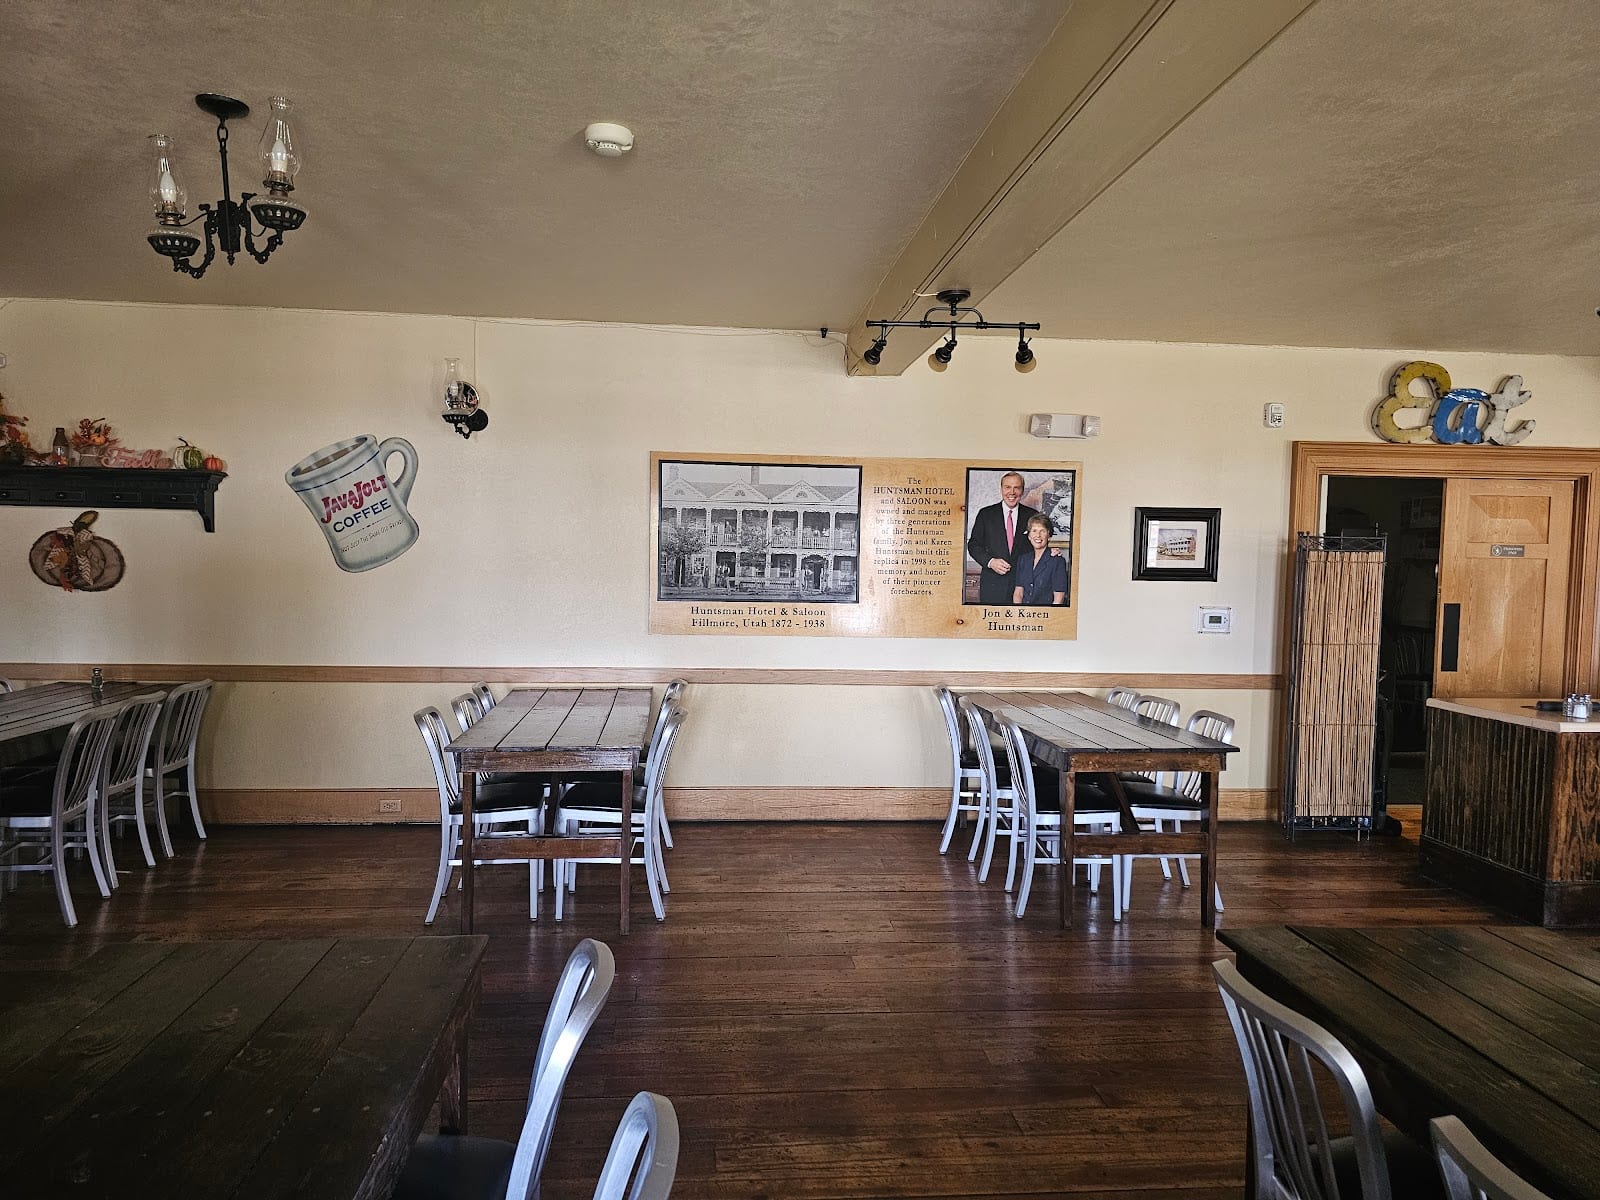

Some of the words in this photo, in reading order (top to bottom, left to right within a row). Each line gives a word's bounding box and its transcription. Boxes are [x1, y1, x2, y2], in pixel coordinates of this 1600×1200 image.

[1371, 361, 1537, 446] Eat
[101, 447, 163, 468] Fall
[874, 487, 923, 495] HUNTSMAN
[925, 487, 955, 496] HOTEL
[897, 497, 931, 505] SALOON
[334, 498, 392, 533] COFFEE
[918, 509, 951, 517] managed
[908, 519, 951, 527] generations
[906, 528, 944, 536] Huntsman
[899, 538, 913, 546] Jon
[931, 538, 952, 546] Karen
[873, 558, 899, 566] replica
[877, 568, 906, 576] memory
[913, 579, 941, 587] pioneer
[691, 607, 744, 616] Huntsman
[748, 607, 776, 616] Hotel
[780, 608, 789, 616] &
[793, 608, 827, 616] Saloon
[982, 609, 1000, 619] Jon
[1005, 610, 1013, 618] &
[1018, 609, 1049, 618] Karen
[691, 619, 739, 629] Fillmore,
[743, 619, 767, 627] Utah
[771, 620, 792, 628] 1872
[804, 620, 826, 628] 1938
[988, 622, 1044, 632] Huntsman
